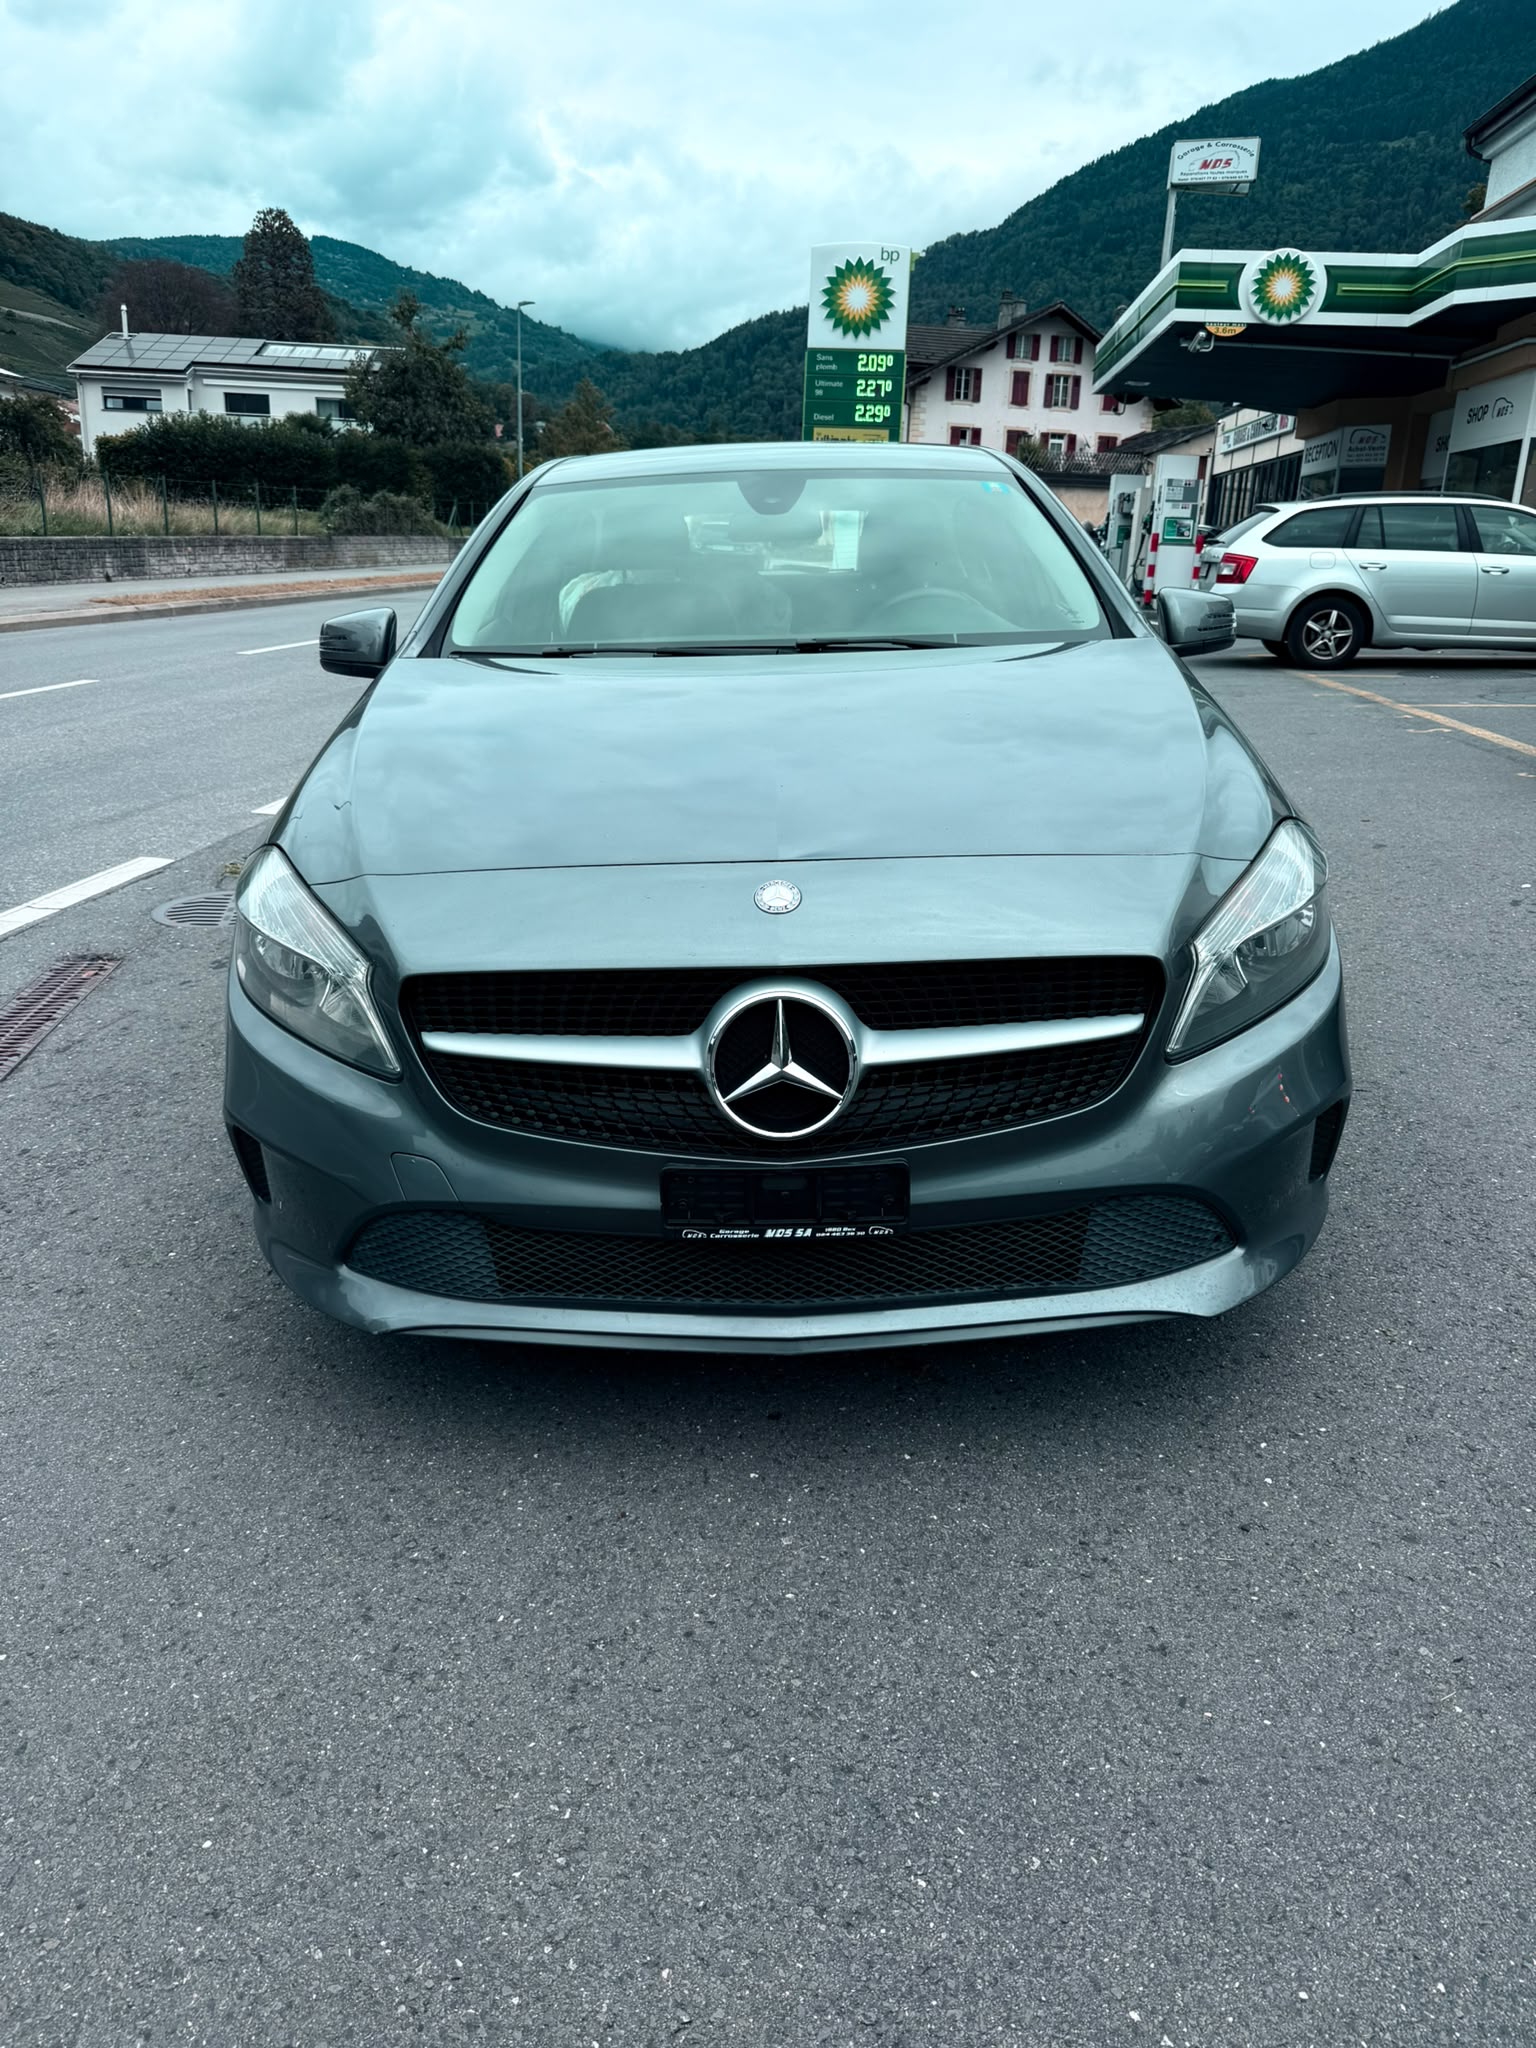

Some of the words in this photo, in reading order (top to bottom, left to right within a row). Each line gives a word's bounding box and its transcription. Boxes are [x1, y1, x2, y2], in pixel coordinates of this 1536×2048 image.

[1177, 145, 1204, 160] Garage
[1215, 141, 1255, 157] Carrosserie
[881, 246, 900, 265] bp
[816, 353, 833, 361] Sans
[815, 363, 838, 371] plomb
[815, 379, 843, 387] Ultimate
[813, 413, 834, 421] Diesel
[1466, 404, 1489, 425] SHOP
